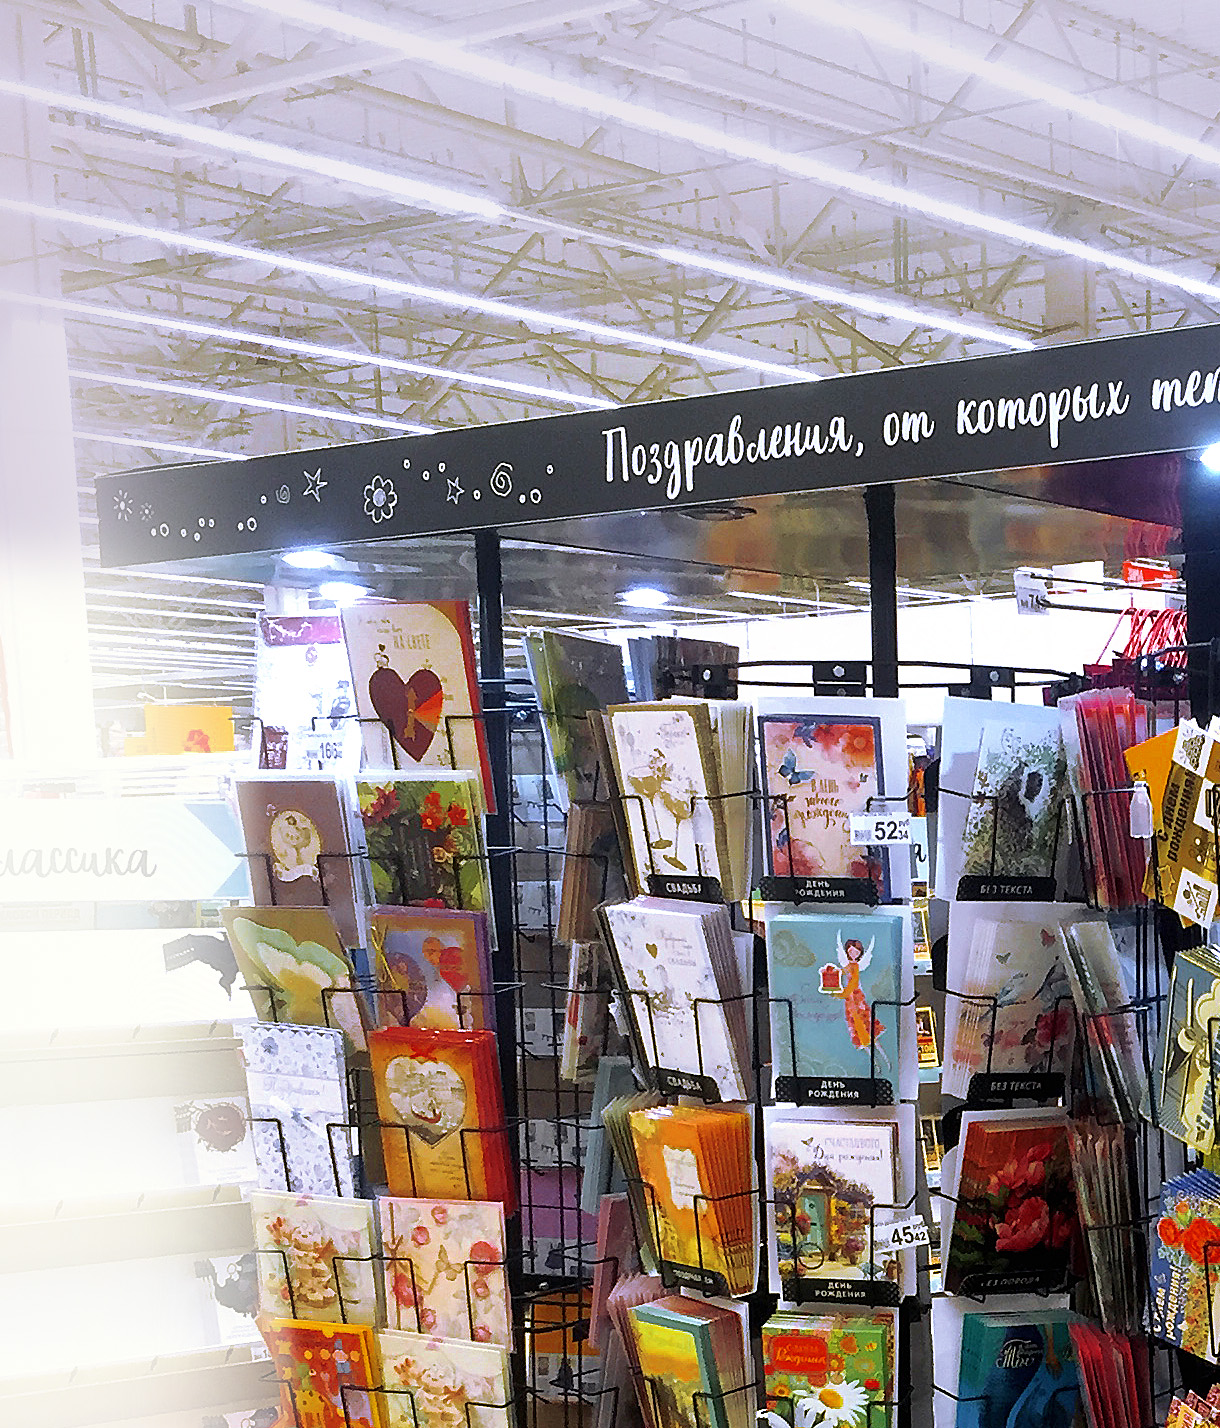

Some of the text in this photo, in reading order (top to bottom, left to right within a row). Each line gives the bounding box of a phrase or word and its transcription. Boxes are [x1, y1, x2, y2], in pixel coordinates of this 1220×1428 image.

[602, 415, 864, 500] Поздравления,
[884, 412, 934, 446] от
[957, 381, 1130, 448] которых
[875, 821, 897, 840] 52
[0, 847, 157, 877] лассика
[805, 880, 831, 888] ДЕНЬ
[1000, 884, 1033, 894] ТЕКСТА
[820, 1080, 846, 1089] ДЕНЬ
[991, 1081, 1042, 1091] БЕЗ ТЕКСТА
[808, 1089, 859, 1098] РОЖДЕНИЯ
[891, 1226, 914, 1246] 45
[914, 1231, 926, 1242] 42
[828, 1281, 852, 1289] ДЕНЬ
[815, 1290, 866, 1298] РОЖДЕНИЯ
